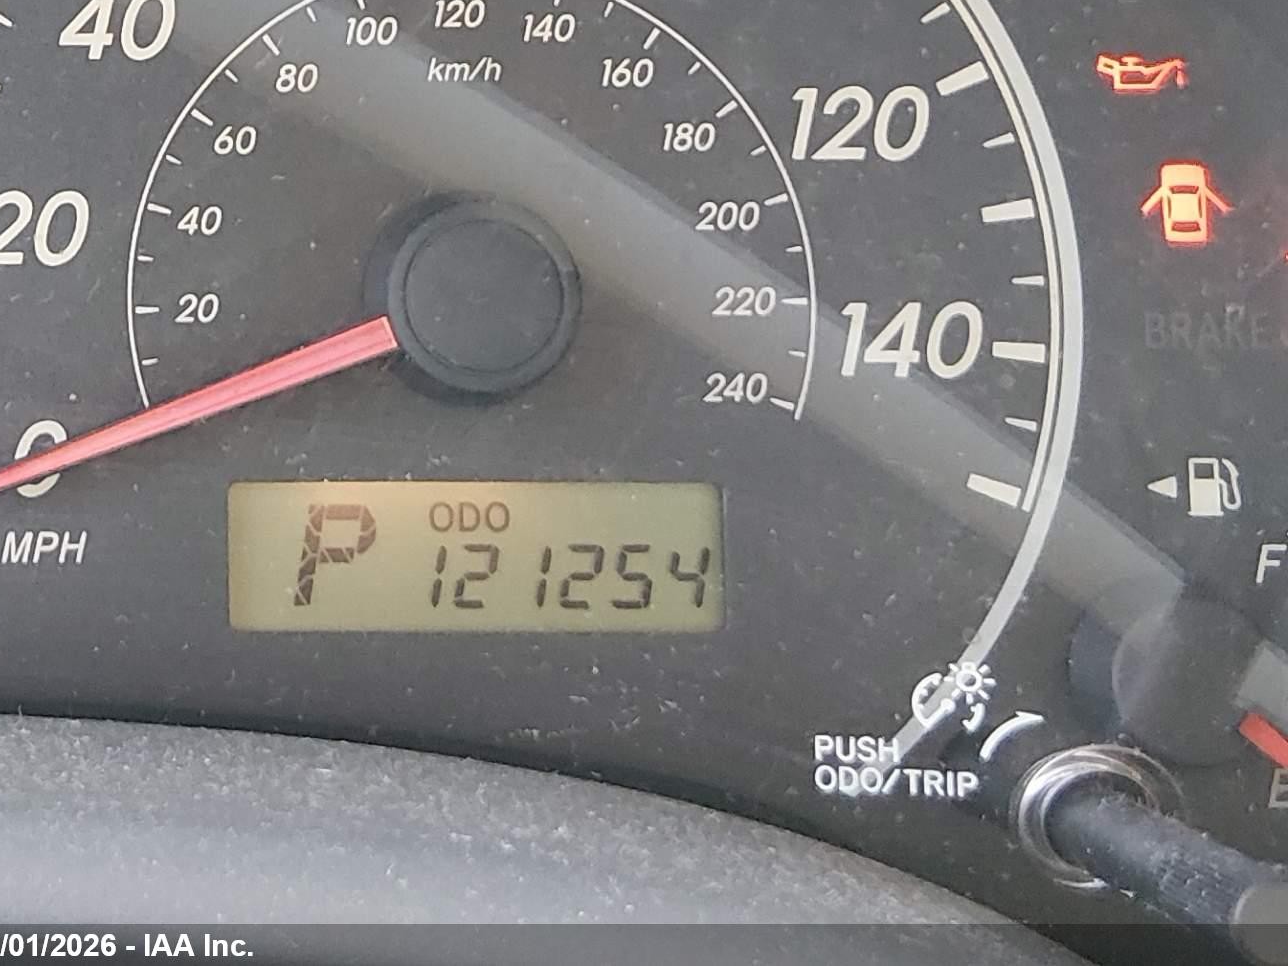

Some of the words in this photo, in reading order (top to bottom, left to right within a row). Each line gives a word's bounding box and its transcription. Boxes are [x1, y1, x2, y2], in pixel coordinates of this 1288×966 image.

[435, 0, 485, 27] 120
[524, 14, 575, 42] 140
[347, 17, 397, 45] 100
[276, 64, 317, 92] 80
[428, 58, 501, 82] km/h
[603, 59, 653, 87] 160
[664, 123, 715, 151] 180
[792, 86, 929, 161] 120
[213, 126, 257, 155] 60
[178, 207, 221, 235] 40
[696, 202, 759, 231] 200
[175, 294, 218, 323] 20
[712, 287, 776, 316] 220
[841, 302, 982, 379] 140
[1144, 310, 1272, 349] BRAKE
[703, 373, 767, 403] 240
[429, 502, 510, 533] ODO
[2, 531, 86, 563] MPH
[292, 503, 377, 607] P
[430, 543, 712, 610] 121254
[1256, 544, 1287, 583] F
[813, 732, 901, 764] PUSH
[813, 764, 980, 797] ODO/TRIP
